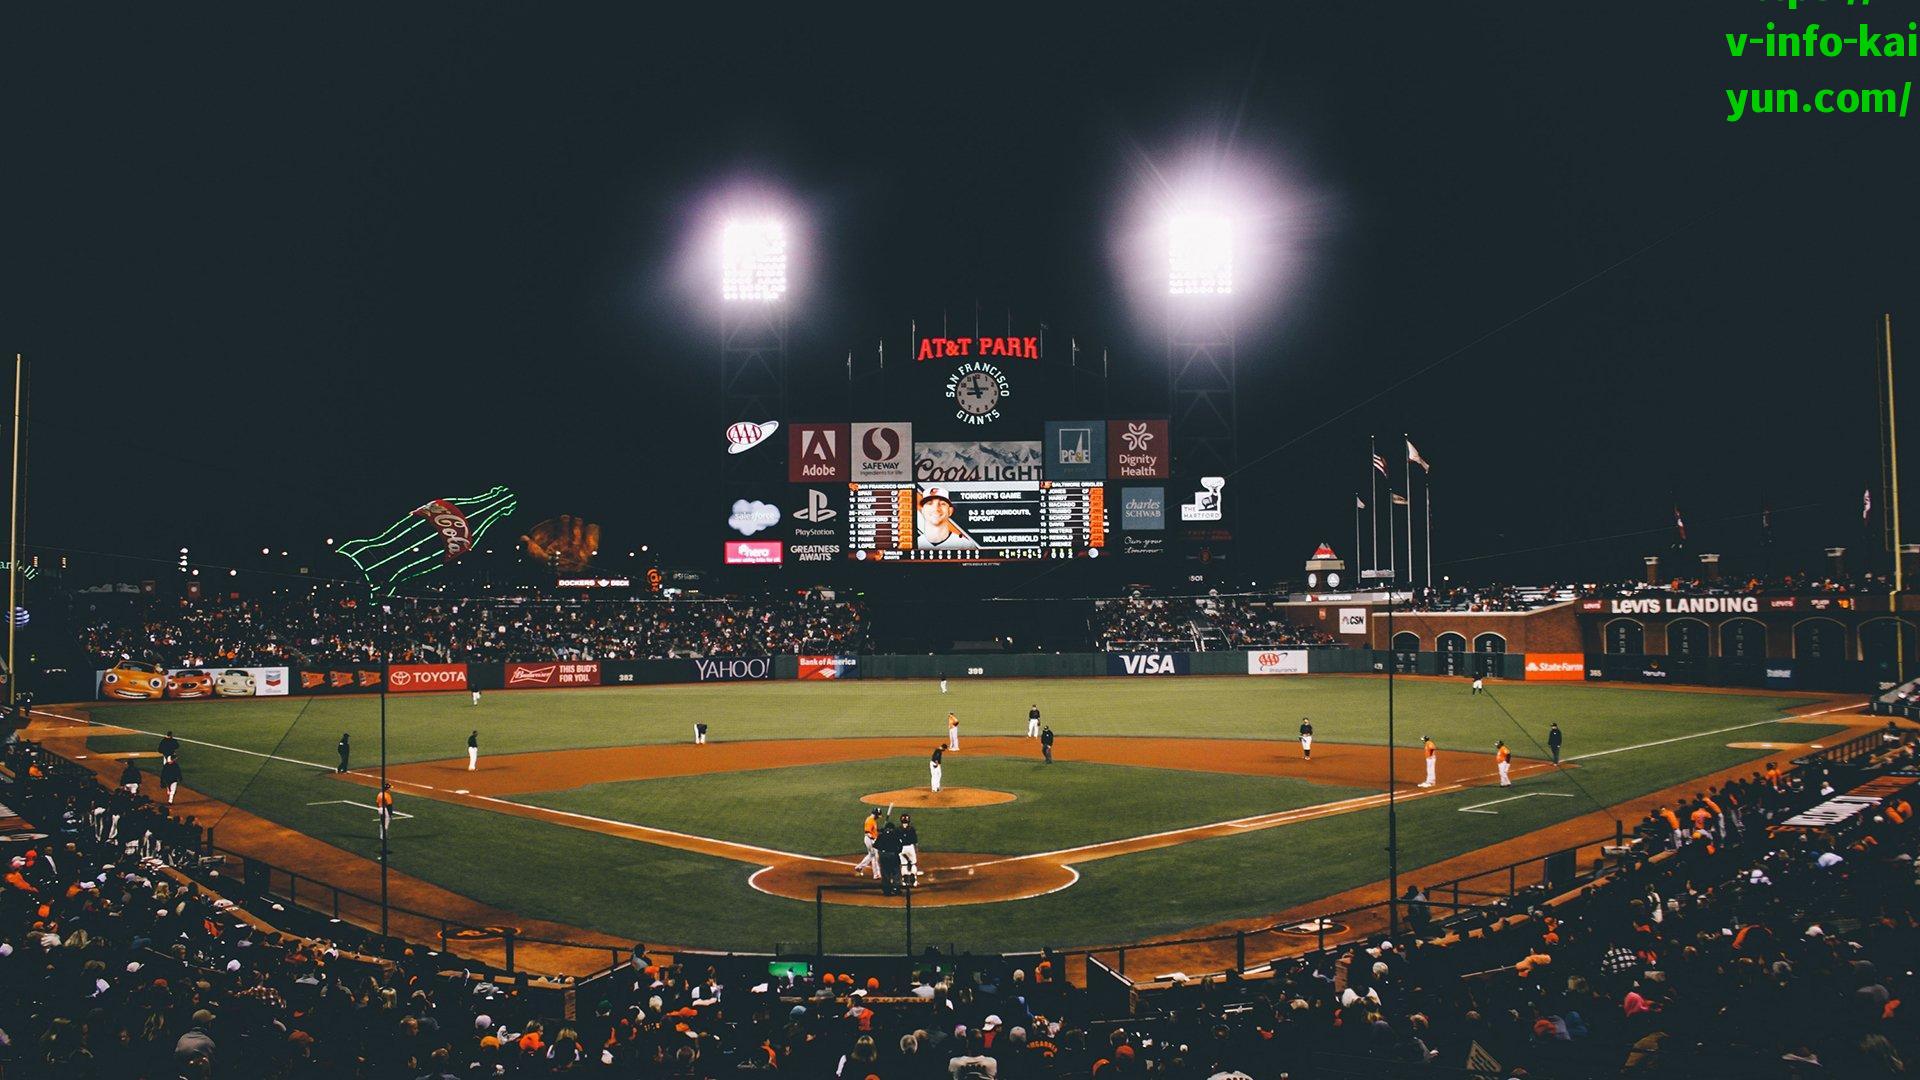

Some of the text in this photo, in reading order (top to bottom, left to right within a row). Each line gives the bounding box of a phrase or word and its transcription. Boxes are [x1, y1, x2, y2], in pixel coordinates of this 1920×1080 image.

[918, 337, 1038, 360] AT&T PARK
[946, 362, 1009, 398] SAN FRANCISCO
[956, 409, 1000, 425] GIANTS
[729, 424, 762, 444] AAA
[1062, 449, 1089, 462] PG&E
[1119, 454, 1157, 467] Dignity
[802, 465, 836, 476] Adobe
[862, 462, 899, 470] SAFEWAY
[915, 458, 1043, 481] Coors LIGHT
[1121, 466, 1156, 476] Health
[1126, 499, 1160, 509] charles
[734, 512, 776, 522] salesforce
[434, 514, 470, 554] Cola
[796, 528, 834, 537] PlayStation
[790, 545, 839, 553] GREATNESS
[1666, 597, 1758, 613] LANDING
[1350, 616, 1364, 625] CSN
[1119, 654, 1175, 674] VISA
[1258, 653, 1280, 666] AAA
[514, 670, 552, 679] Budweiser
[560, 664, 597, 673] THIS BUD'S
[696, 658, 770, 680] YAHOO!
[414, 672, 466, 682] TOYOTA
[560, 674, 573, 682] FOR
